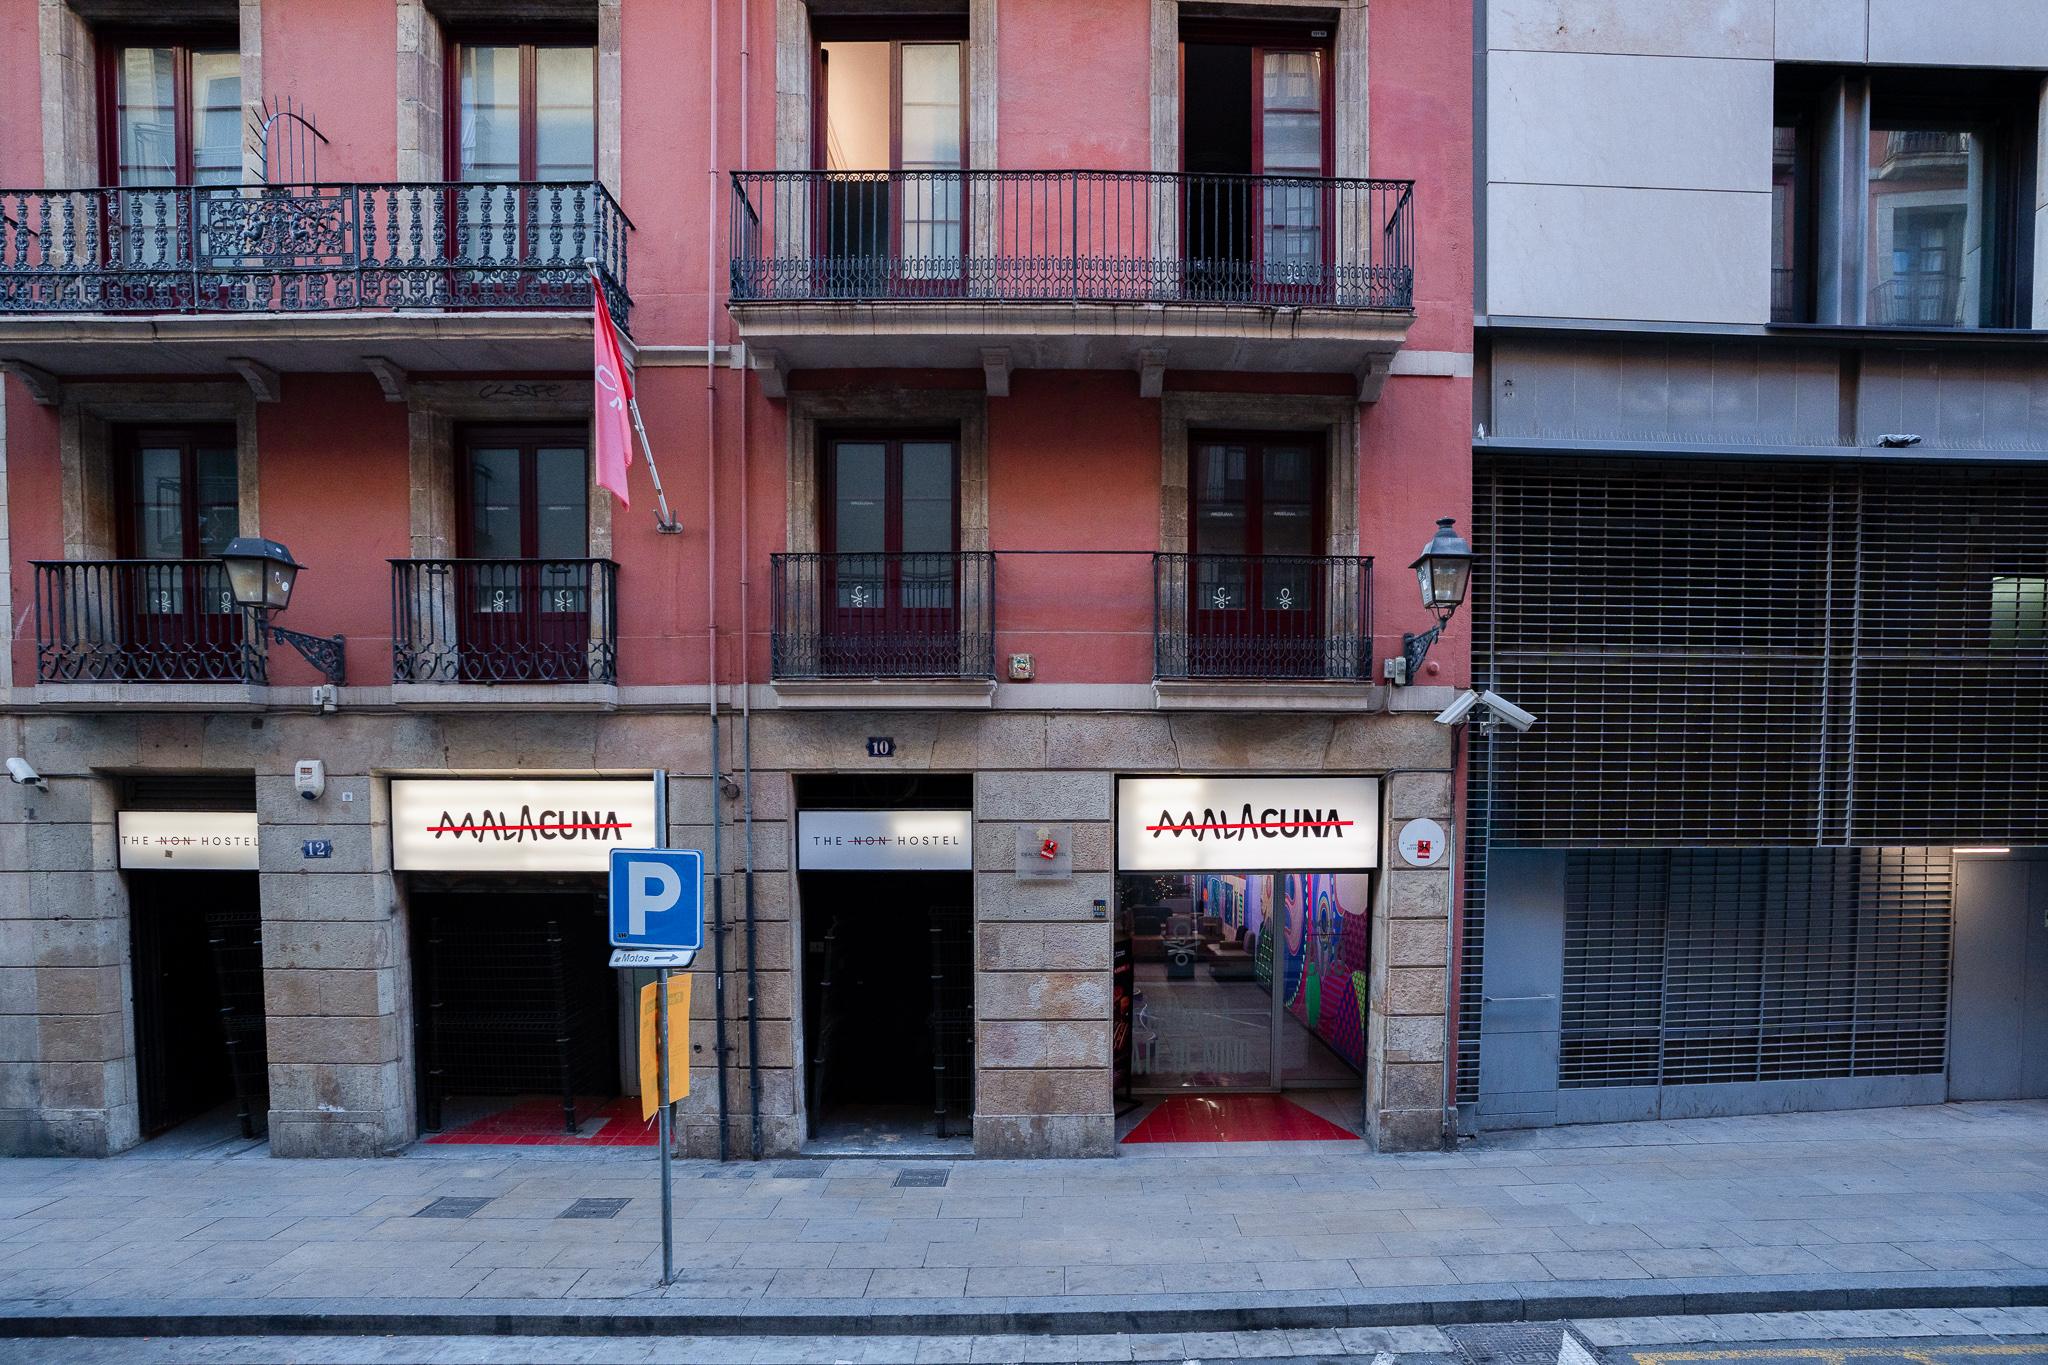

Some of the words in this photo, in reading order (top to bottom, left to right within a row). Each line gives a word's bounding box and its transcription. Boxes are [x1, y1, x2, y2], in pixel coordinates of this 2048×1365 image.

[872, 740, 889, 755] 10
[434, 804, 623, 843] MALACUNA
[1153, 803, 1343, 842] MALACUNA
[121, 836, 149, 846] THE
[159, 836, 192, 846] NON
[201, 836, 259, 847] HOSTEL
[813, 836, 843, 846] THE
[853, 836, 887, 846] NON
[897, 836, 959, 846] HOSTEL
[308, 842, 325, 856] 12
[628, 861, 682, 936] P
[621, 953, 650, 963] Motos
